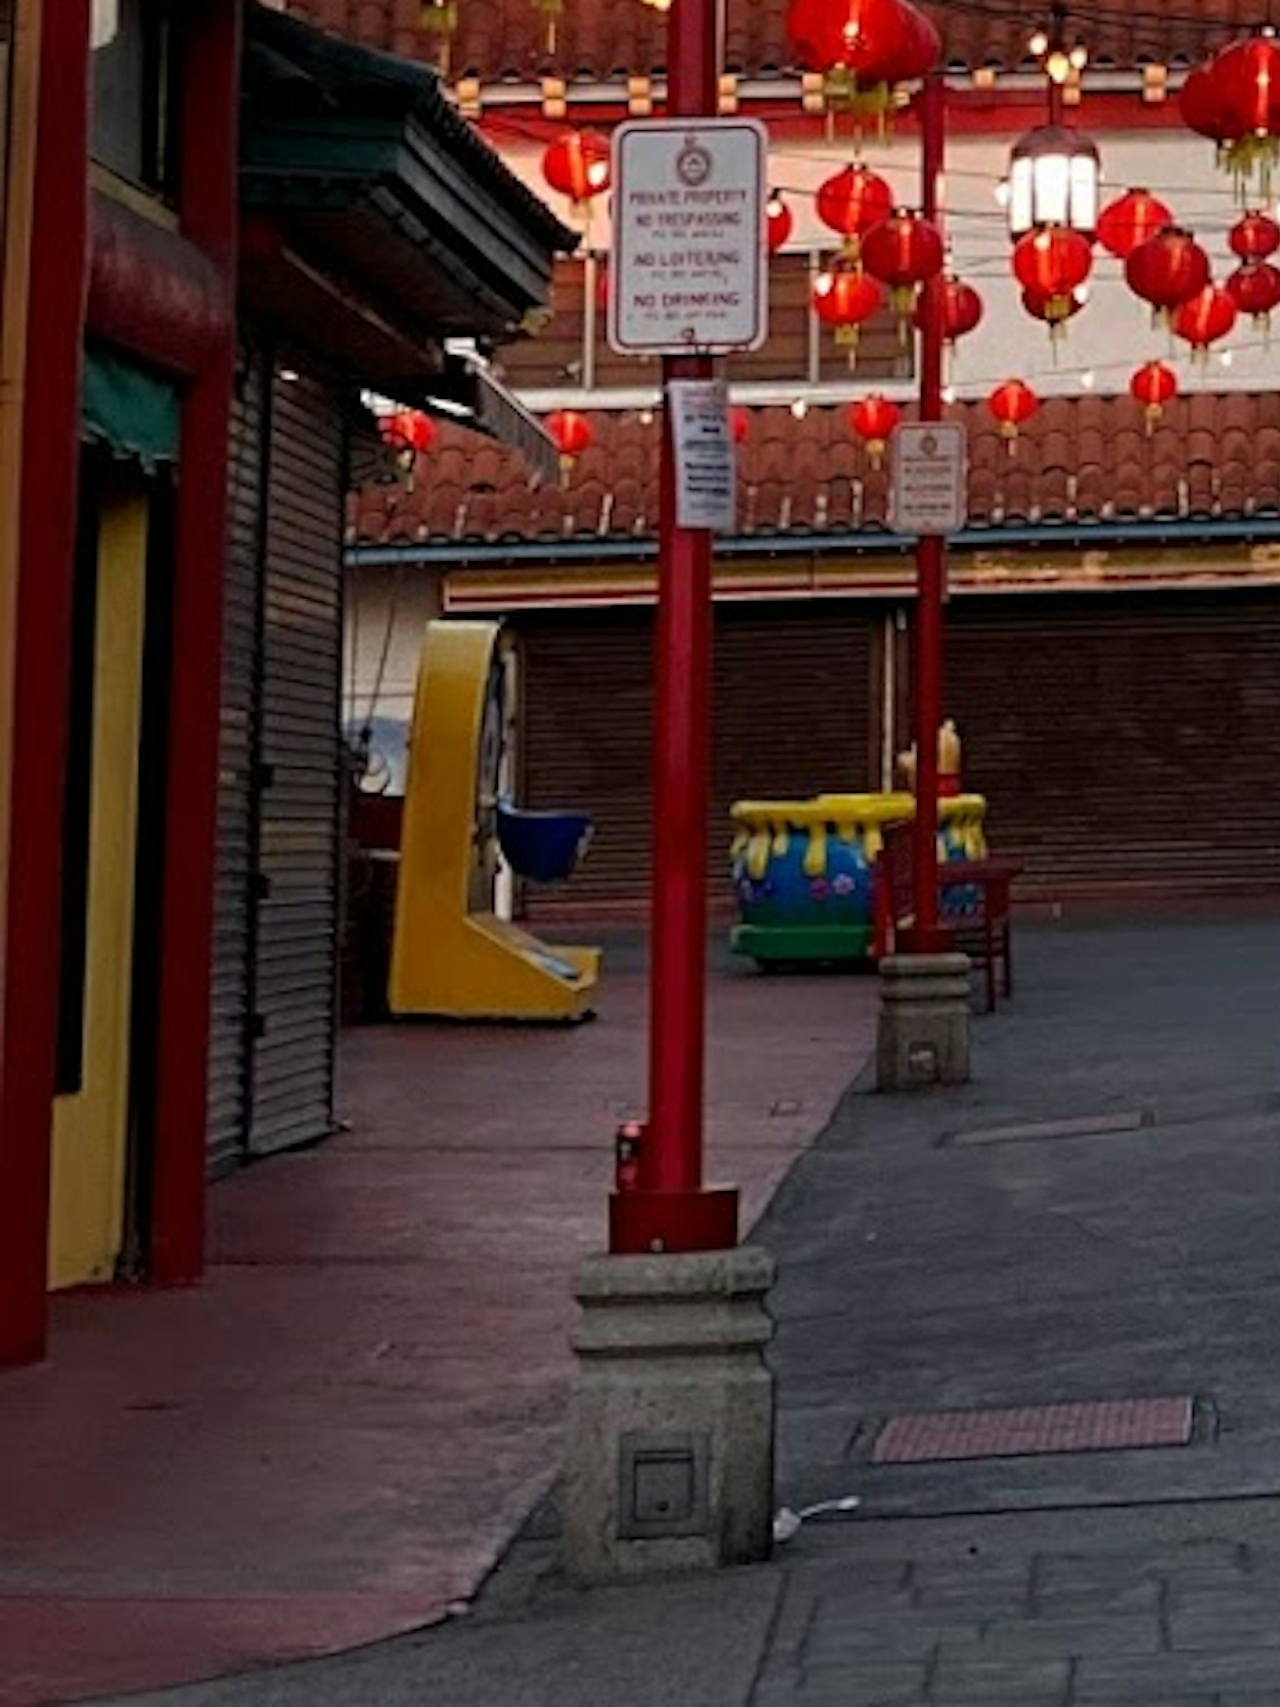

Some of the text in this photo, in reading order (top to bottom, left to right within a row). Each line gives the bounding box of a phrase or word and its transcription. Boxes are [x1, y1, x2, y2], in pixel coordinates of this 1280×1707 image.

[684, 189, 746, 205] PROPERTY
[658, 212, 741, 227] TRESPASSING
[634, 250, 740, 267] NO LOITERING
[634, 292, 740, 308] NO DRINKING
